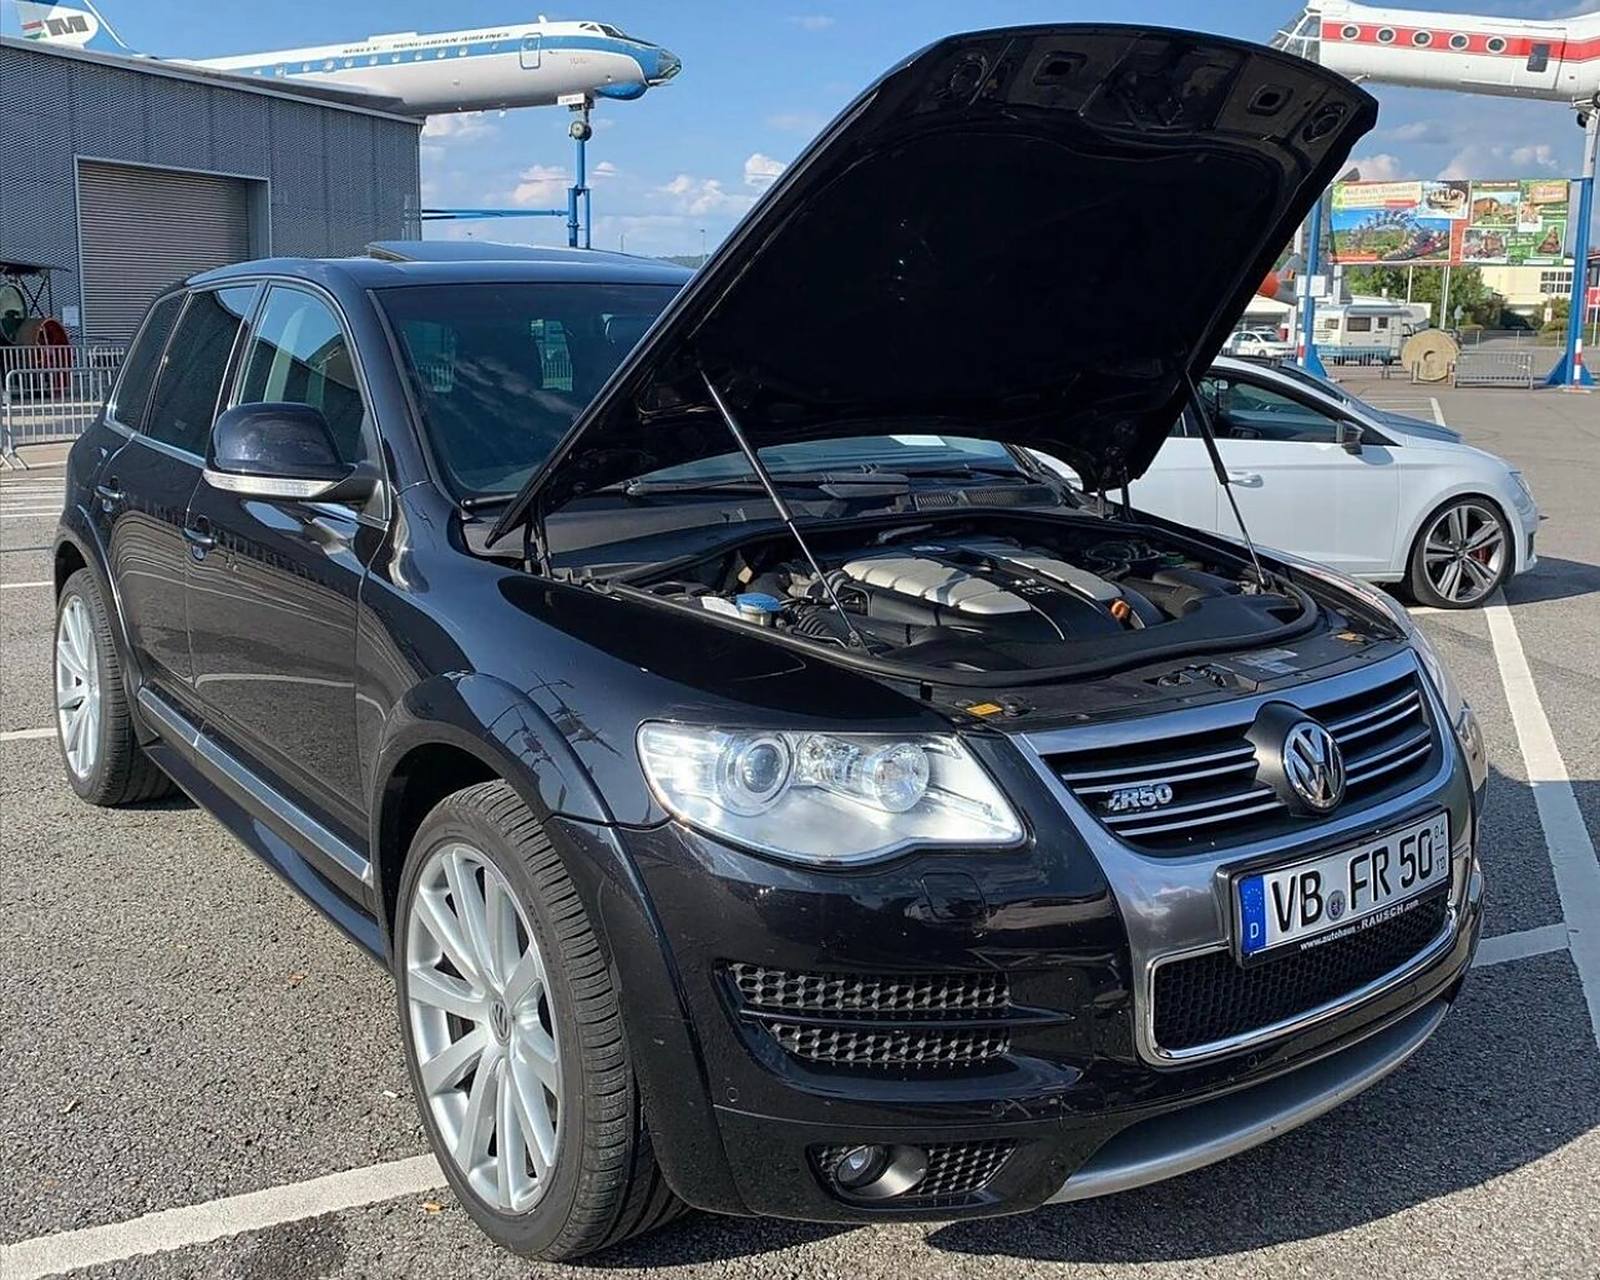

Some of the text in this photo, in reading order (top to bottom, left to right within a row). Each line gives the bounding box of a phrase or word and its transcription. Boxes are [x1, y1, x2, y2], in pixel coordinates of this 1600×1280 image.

[1271, 828, 1433, 933] VB FR 50
[1250, 922, 1259, 939] D
